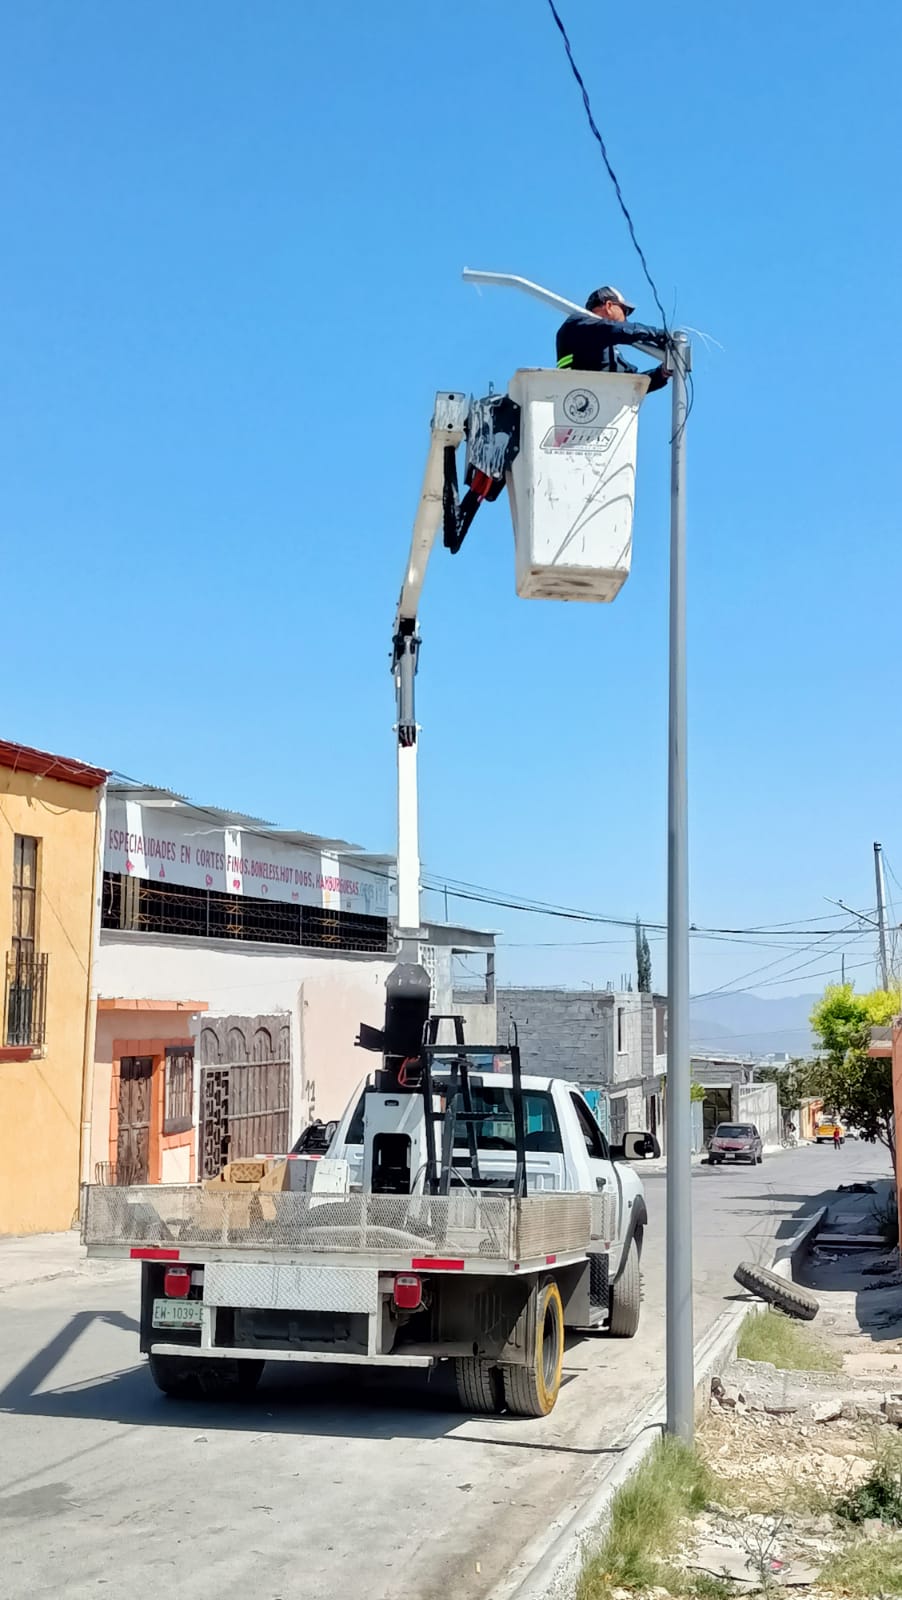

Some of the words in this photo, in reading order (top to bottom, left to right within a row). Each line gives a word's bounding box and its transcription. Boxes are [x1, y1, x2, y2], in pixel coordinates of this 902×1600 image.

[109, 829, 176, 861] ESPECIALIDADES
[180, 845, 191, 864] EN
[196, 848, 224, 871] CORTES
